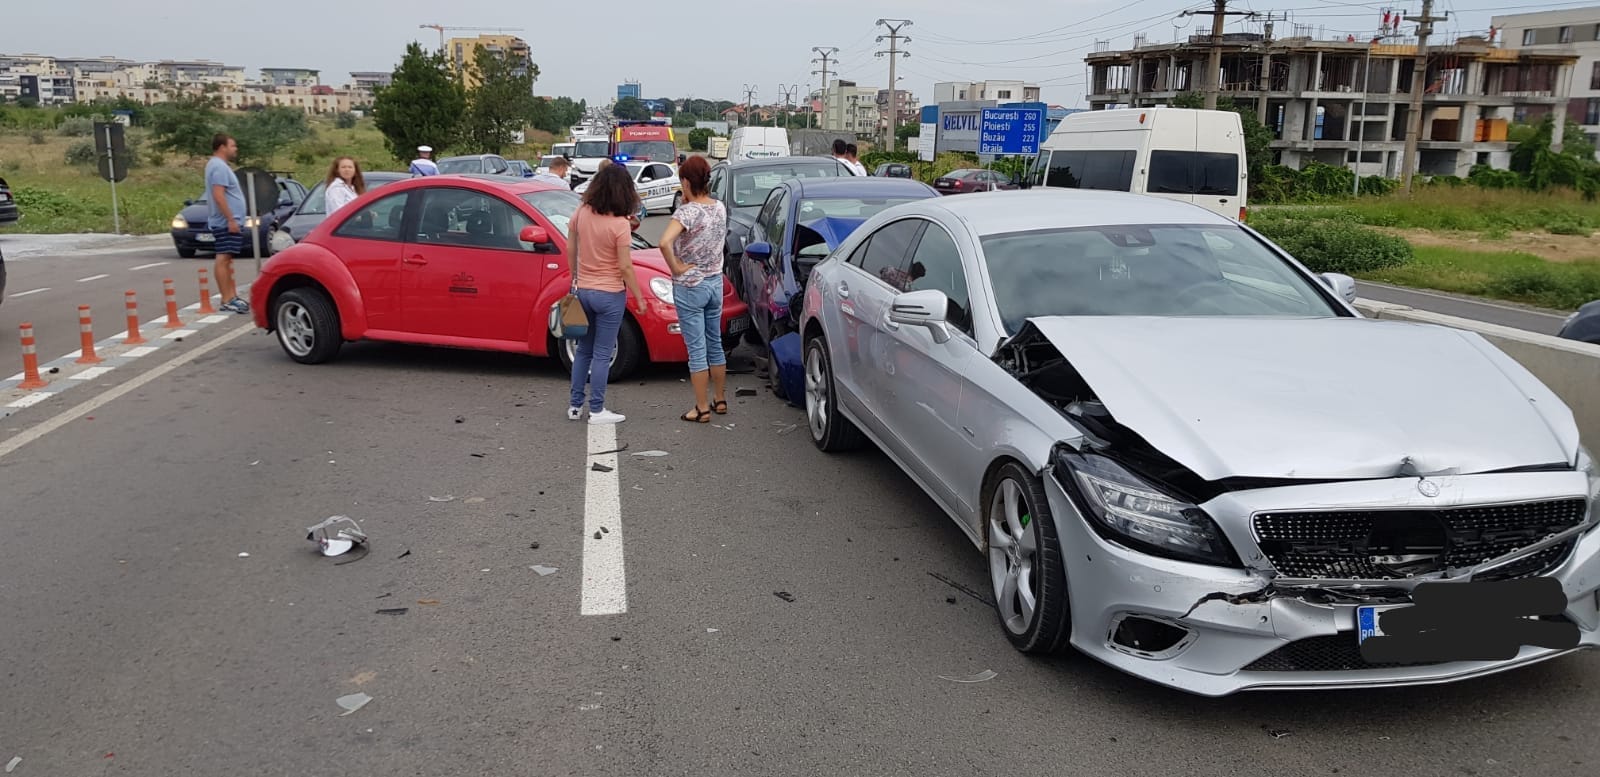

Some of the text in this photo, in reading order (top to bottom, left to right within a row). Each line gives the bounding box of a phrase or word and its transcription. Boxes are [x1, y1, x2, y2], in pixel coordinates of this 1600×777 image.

[1024, 112, 1037, 121] 260
[1023, 123, 1036, 132] 255
[983, 132, 1035, 142] Buzău 223
[1021, 145, 1032, 153] 165
